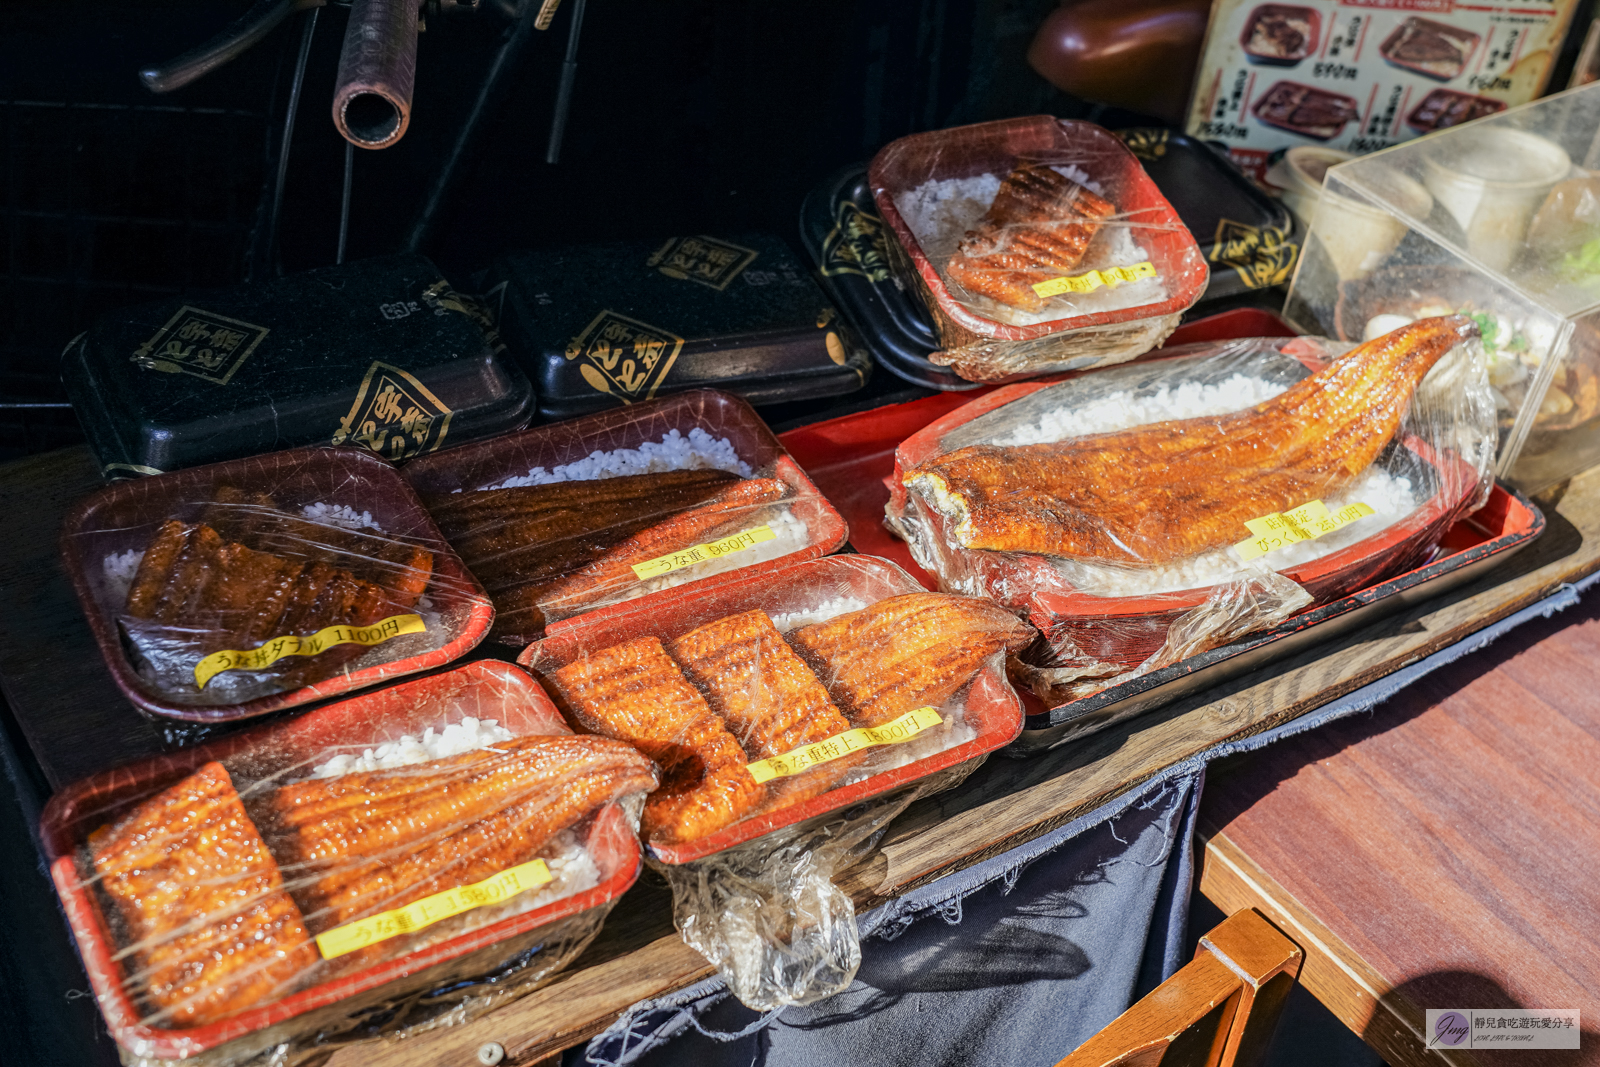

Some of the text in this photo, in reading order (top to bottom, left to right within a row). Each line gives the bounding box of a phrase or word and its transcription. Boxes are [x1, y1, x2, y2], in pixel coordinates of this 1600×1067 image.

[1101, 269, 1137, 284] 90円
[1316, 506, 1363, 532] 2500円
[660, 532, 755, 571] うな重 960円
[334, 619, 399, 643] 1100円
[862, 715, 920, 743] 1800円
[447, 872, 521, 910] 1580円
